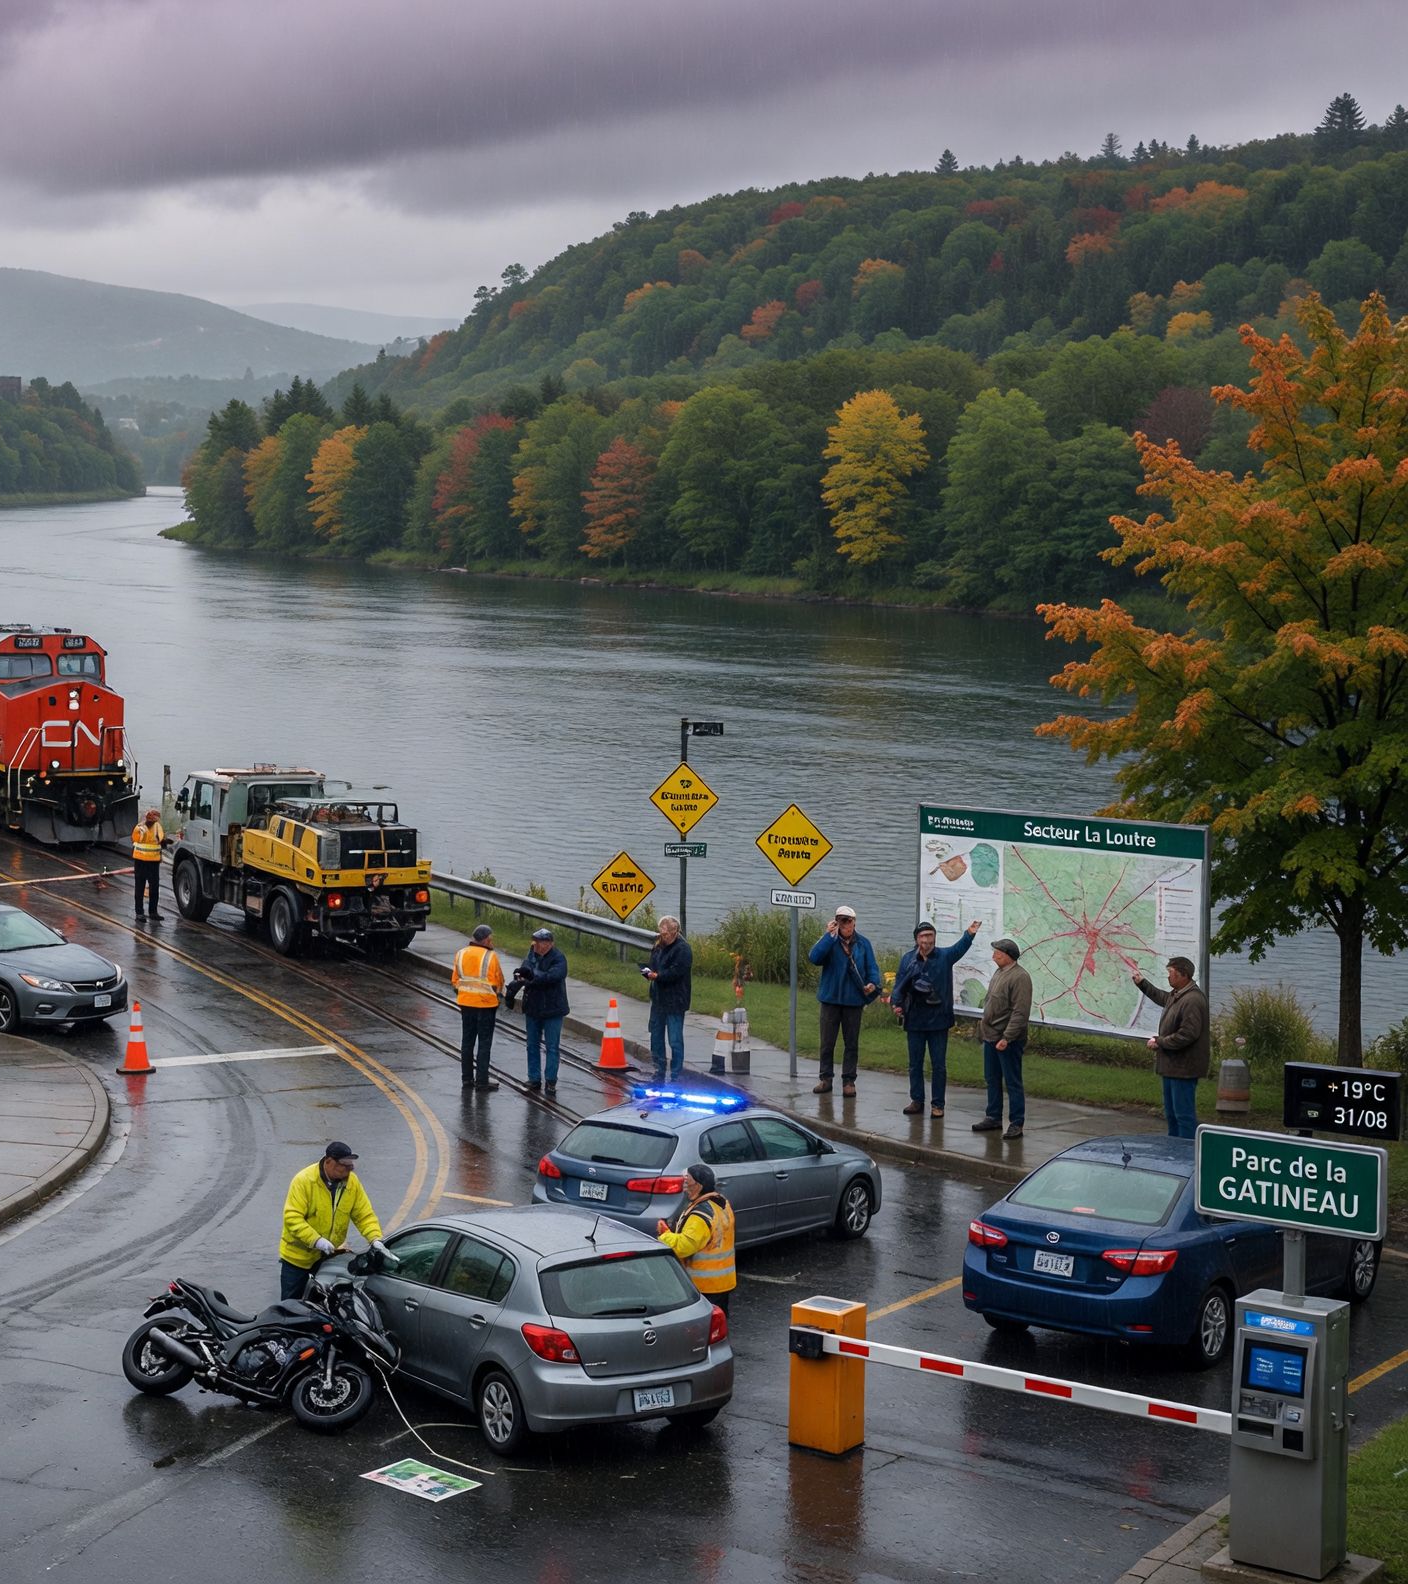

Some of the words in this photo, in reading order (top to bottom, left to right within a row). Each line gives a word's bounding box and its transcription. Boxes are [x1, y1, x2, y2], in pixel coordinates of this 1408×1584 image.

[42, 717, 104, 748] CN
[1024, 821, 1080, 841] Secteur
[1085, 826, 1101, 843] La
[1106, 828, 1157, 848] Loutre
[1327, 1079, 1386, 1102] +19°C
[1334, 1106, 1388, 1130] 31/08
[1231, 1147, 1282, 1175] Parc
[1289, 1156, 1318, 1180] de
[1326, 1159, 1347, 1183] la
[1218, 1176, 1359, 1218] GATINEAU
